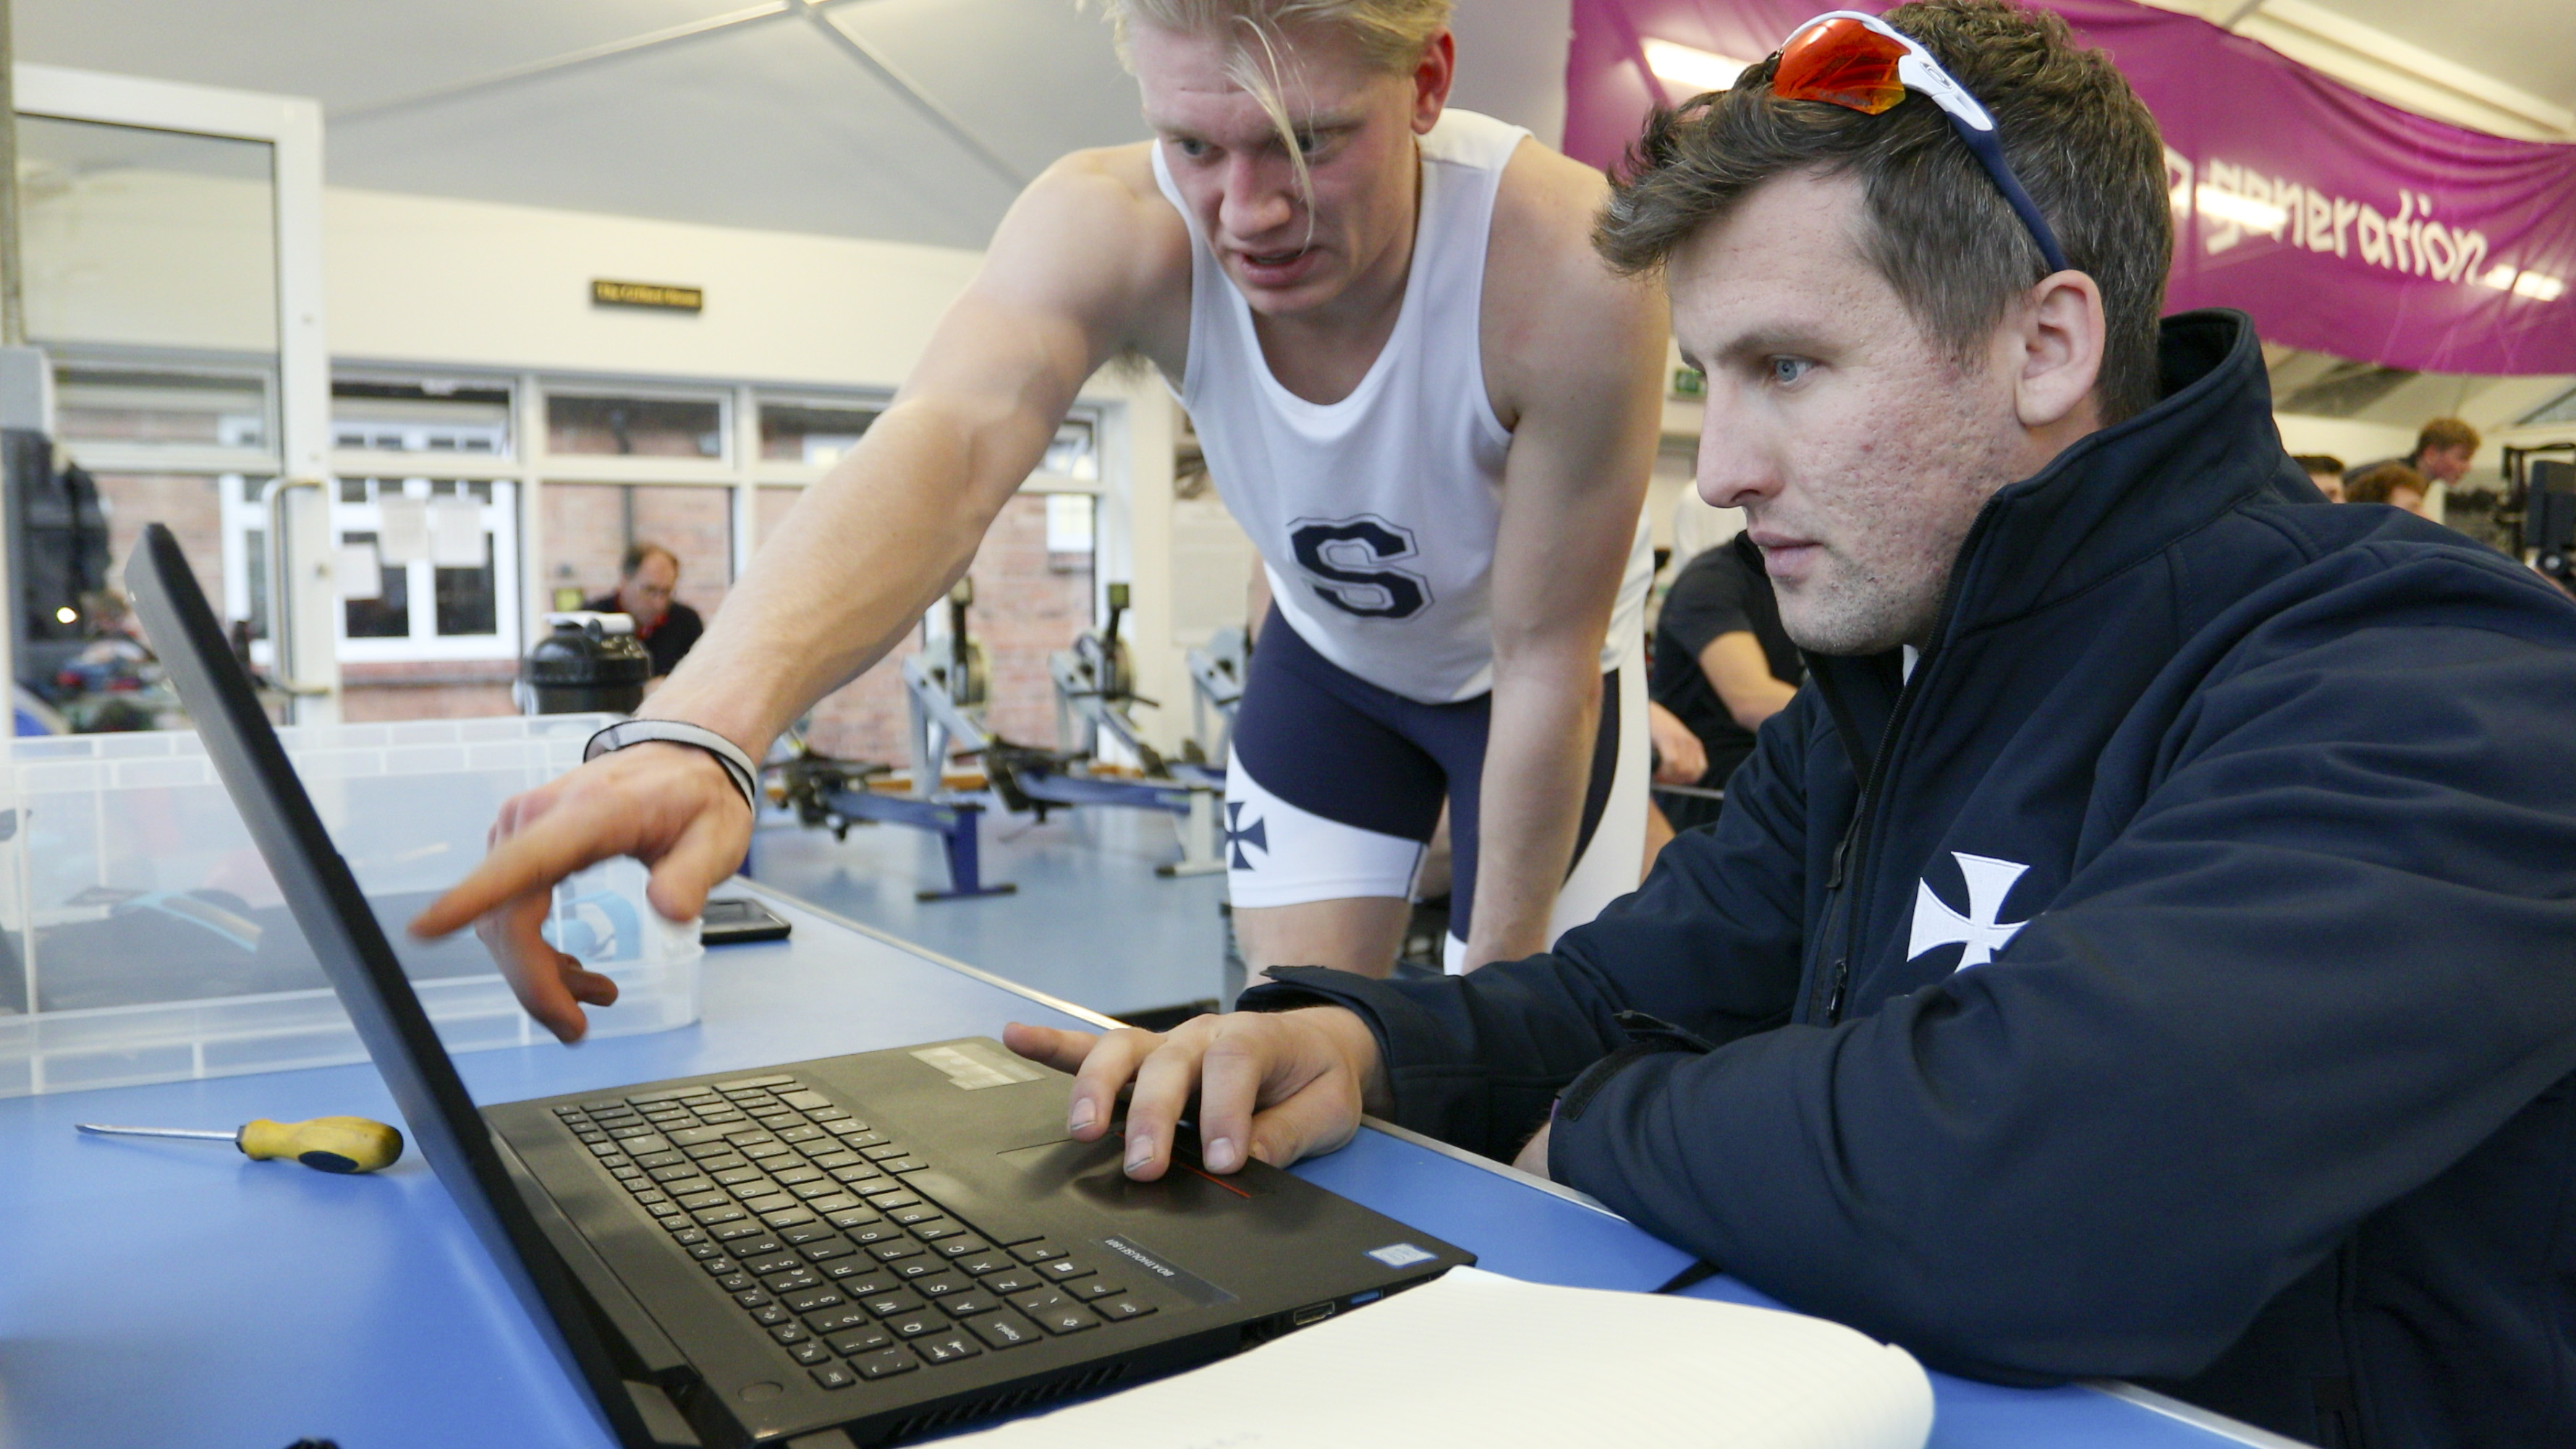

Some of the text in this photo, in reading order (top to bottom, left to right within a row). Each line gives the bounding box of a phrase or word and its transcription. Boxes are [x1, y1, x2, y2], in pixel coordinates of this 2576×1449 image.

[1286, 513, 1434, 621] S
[841, 1216, 858, 1225] H
[834, 1266, 852, 1275] R
[906, 1266, 925, 1275] D
[972, 1262, 991, 1271] X
[855, 1284, 875, 1293] E
[930, 1284, 948, 1293] S
[998, 1280, 1017, 1289] Z
[876, 1301, 897, 1312] W
[956, 1302, 975, 1311] A
[842, 1314, 860, 1323] 2
[903, 1322, 923, 1333] Q
